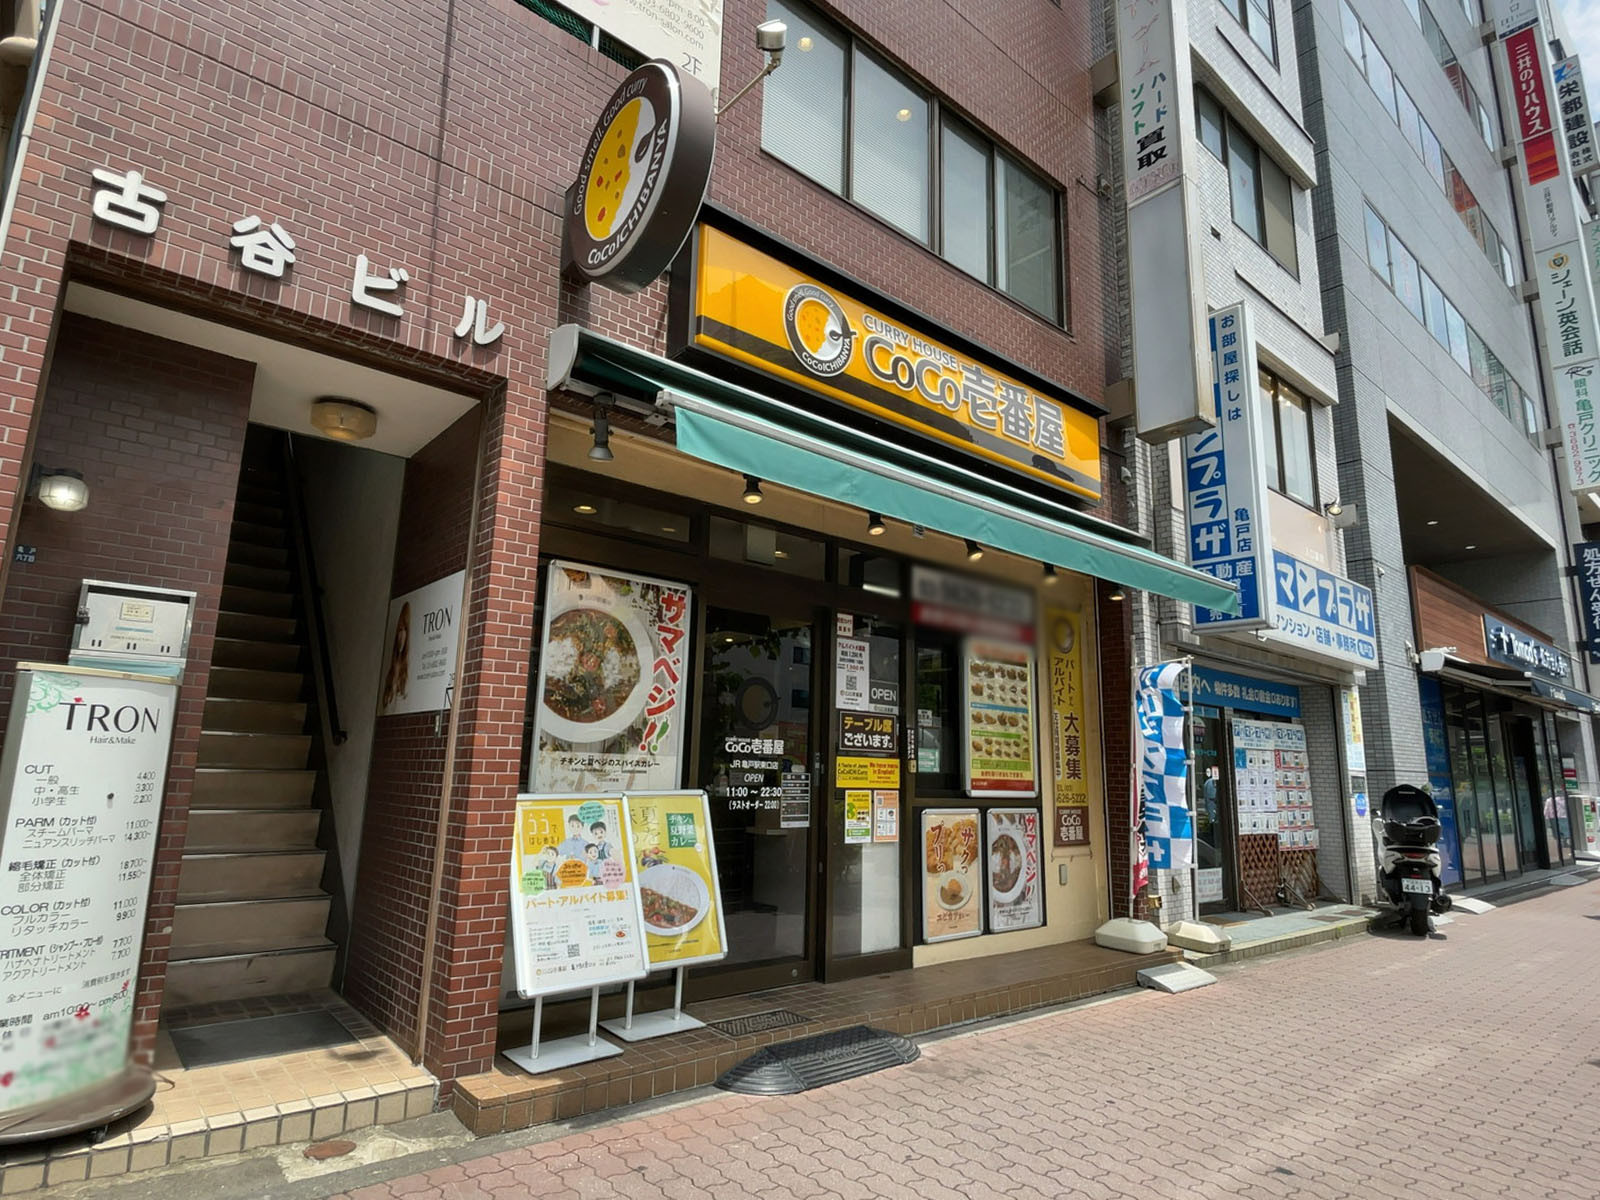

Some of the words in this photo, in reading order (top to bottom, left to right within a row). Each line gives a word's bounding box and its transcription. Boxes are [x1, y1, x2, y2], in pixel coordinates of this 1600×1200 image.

[682, 52, 702, 75] 2F
[1515, 42, 1544, 135] 三井のリハウス
[1151, 72, 1168, 123] ハード
[1131, 82, 1146, 135] ソフト
[573, 174, 588, 215] Good
[626, 77, 648, 95] curry
[587, 117, 668, 265] CoCoICHIBANYA
[91, 168, 505, 346] 古谷ビル
[1551, 269, 1584, 357] シェーン英会話
[862, 313, 909, 346] CURRY
[913, 336, 958, 371] HOUSE
[801, 338, 851, 372] CoCoICHIBANYA
[1220, 315, 1242, 421] お部屋探しは
[863, 333, 1066, 458] CoCo壱番屋
[1233, 507, 1253, 553] 亀戸店
[1276, 562, 1370, 631] マンプラザ
[423, 605, 454, 635] TRON
[1054, 656, 1066, 706] アルバイト
[871, 687, 897, 701] OPEN
[59, 701, 161, 734] TRON
[844, 717, 893, 732] テーブル席
[89, 735, 136, 745] Hair&Make
[725, 738, 785, 754] CoCo壱番屋
[844, 733, 893, 748] ございます。
[1064, 712, 1082, 780] 大募集
[25, 764, 54, 774] CUT
[730, 760, 741, 768] JR
[36, 775, 59, 785] 一般
[744, 773, 764, 782] OPEN
[34, 785, 80, 795] 中・高生
[726, 787, 748, 797] 11:00
[760, 787, 782, 797] 22:30
[32, 797, 67, 806] 小学生
[15, 817, 55, 828] PARM
[1061, 814, 1081, 826] CoCo
[26, 827, 94, 839] スチームパーマ
[1060, 826, 1084, 841] 壱番屋
[22, 835, 116, 849] ニュアンスリッチパーマ
[671, 836, 697, 847] カレー
[19, 869, 67, 882] 全体矯正
[17, 880, 65, 893] 部分矯正
[1, 902, 49, 916] COLOR
[13, 912, 71, 926] フルカラー
[12, 919, 89, 937] リタッチカラー
[2, 961, 87, 982] アクアトリートメント
[6, 986, 62, 1004] 全メニューに
